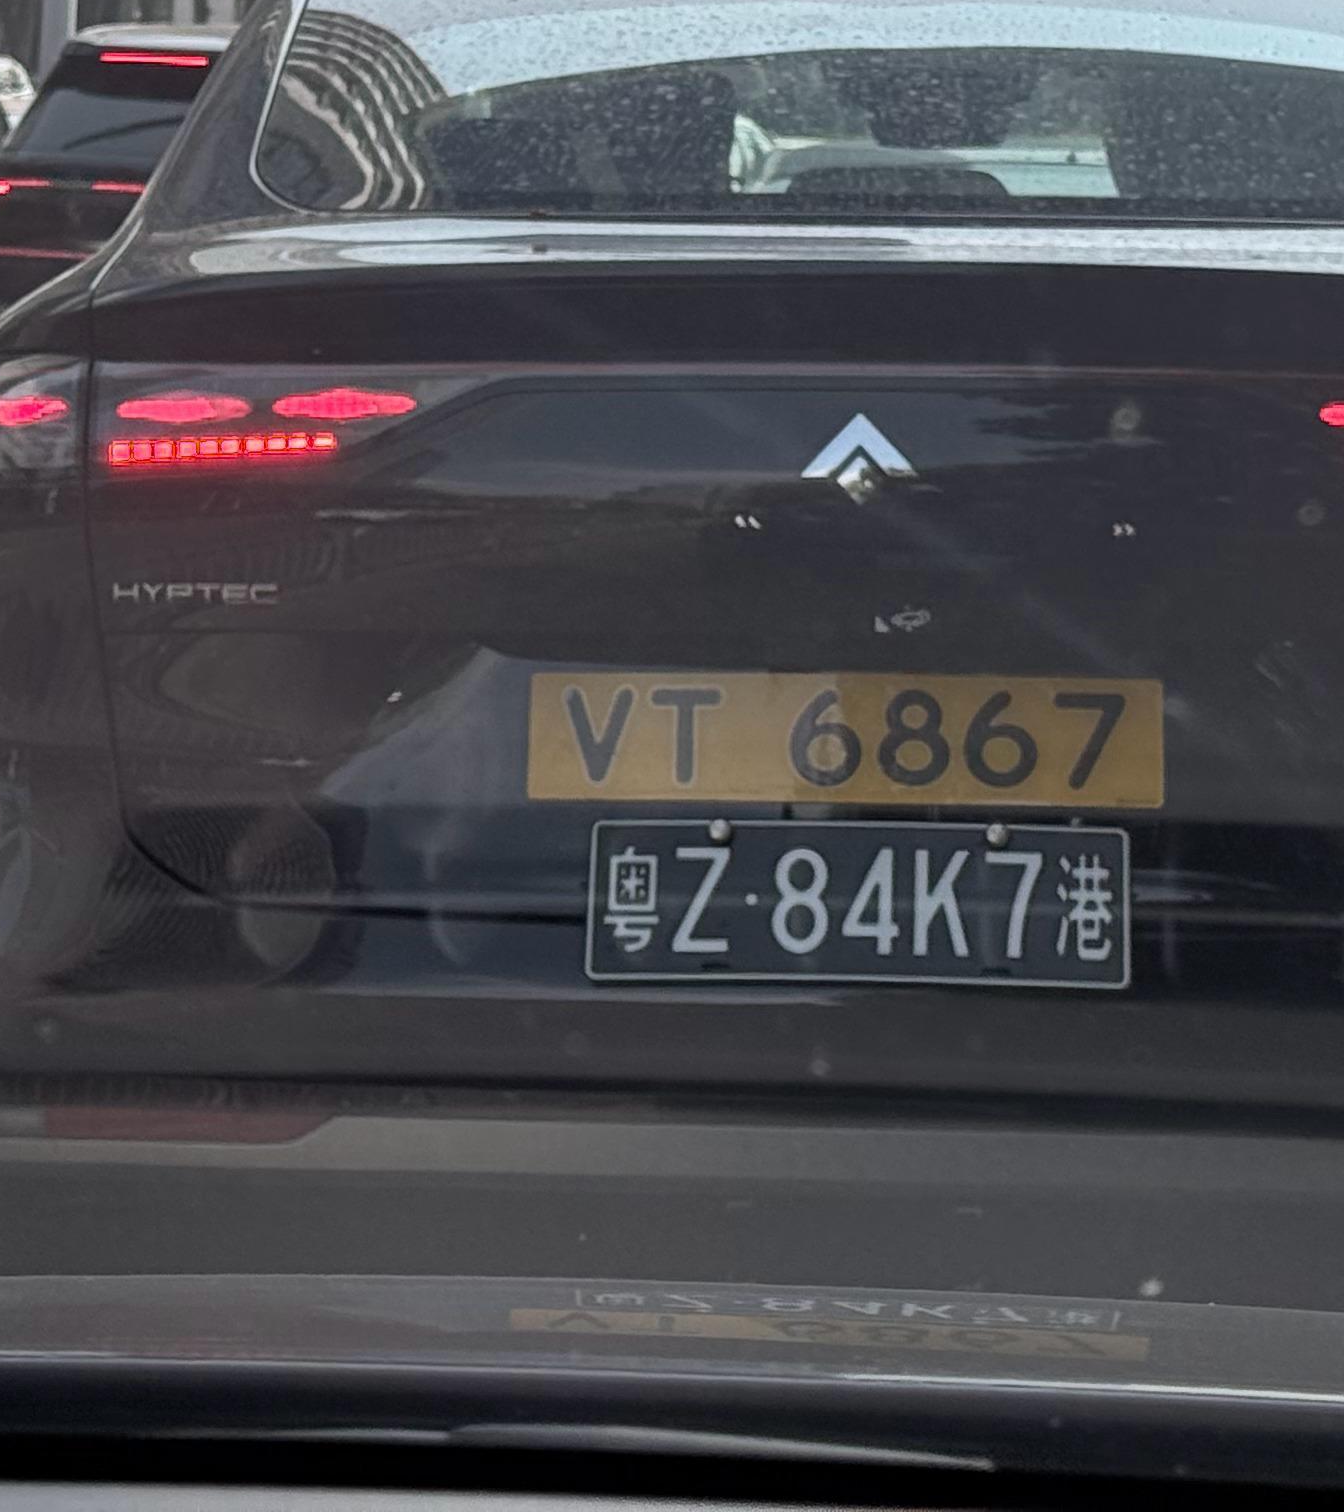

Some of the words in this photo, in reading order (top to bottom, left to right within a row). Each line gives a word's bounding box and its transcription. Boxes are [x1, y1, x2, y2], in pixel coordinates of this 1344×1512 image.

[111, 581, 278, 605] HYPTEC
[565, 685, 720, 785] VT
[789, 688, 1128, 789] 6867
